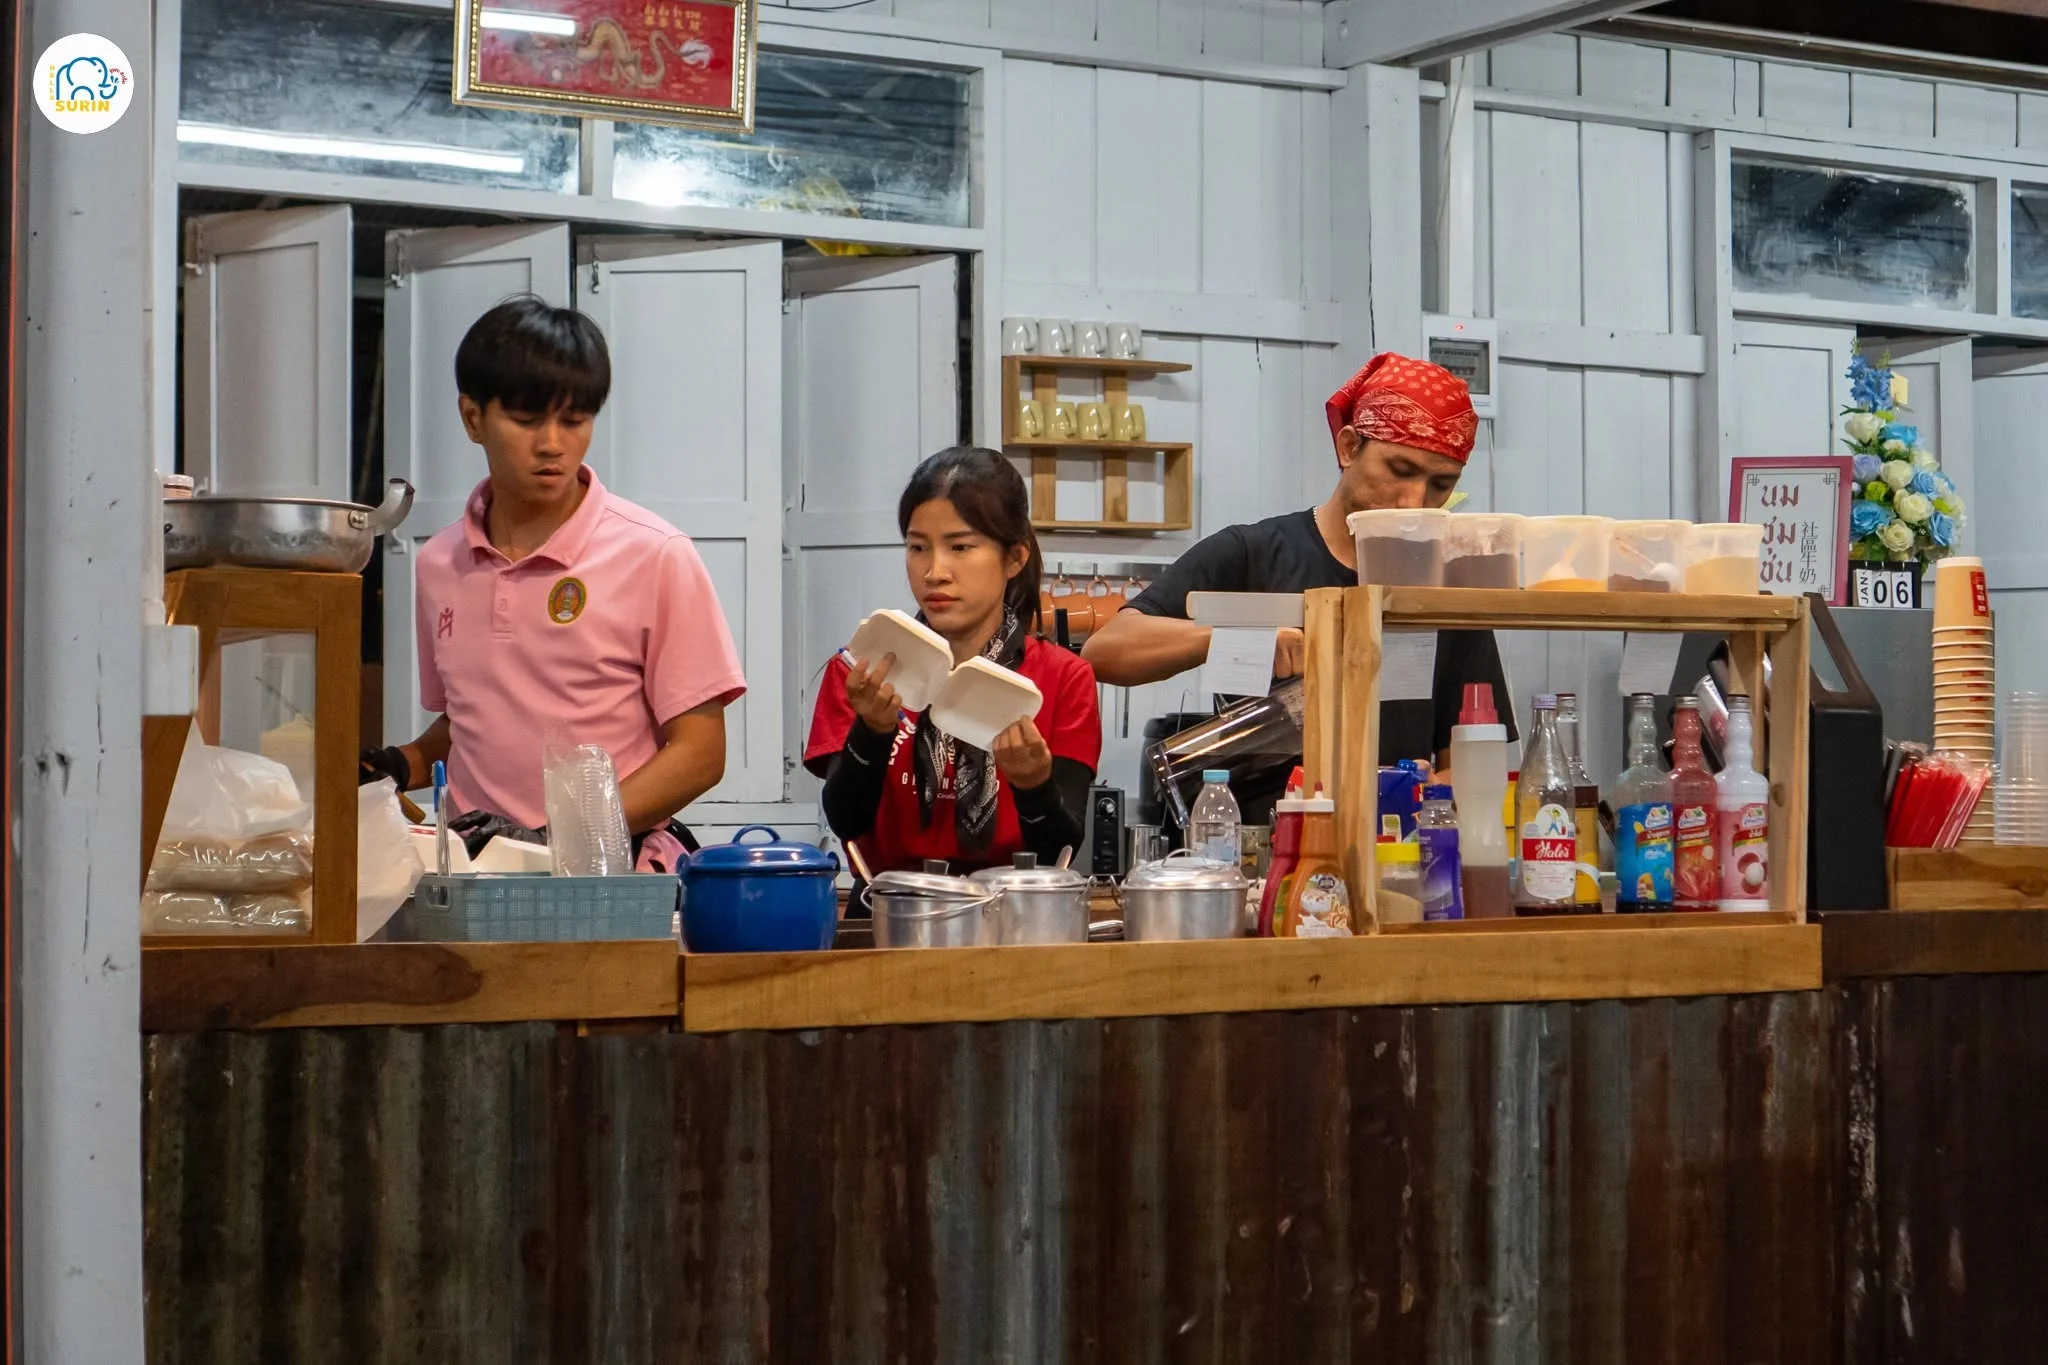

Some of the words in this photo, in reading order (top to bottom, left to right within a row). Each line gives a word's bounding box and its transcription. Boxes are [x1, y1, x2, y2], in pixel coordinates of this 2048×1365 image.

[1760, 484, 1799, 507] นม
[1858, 576, 1869, 604] JAN
[1873, 579, 1910, 605] 06
